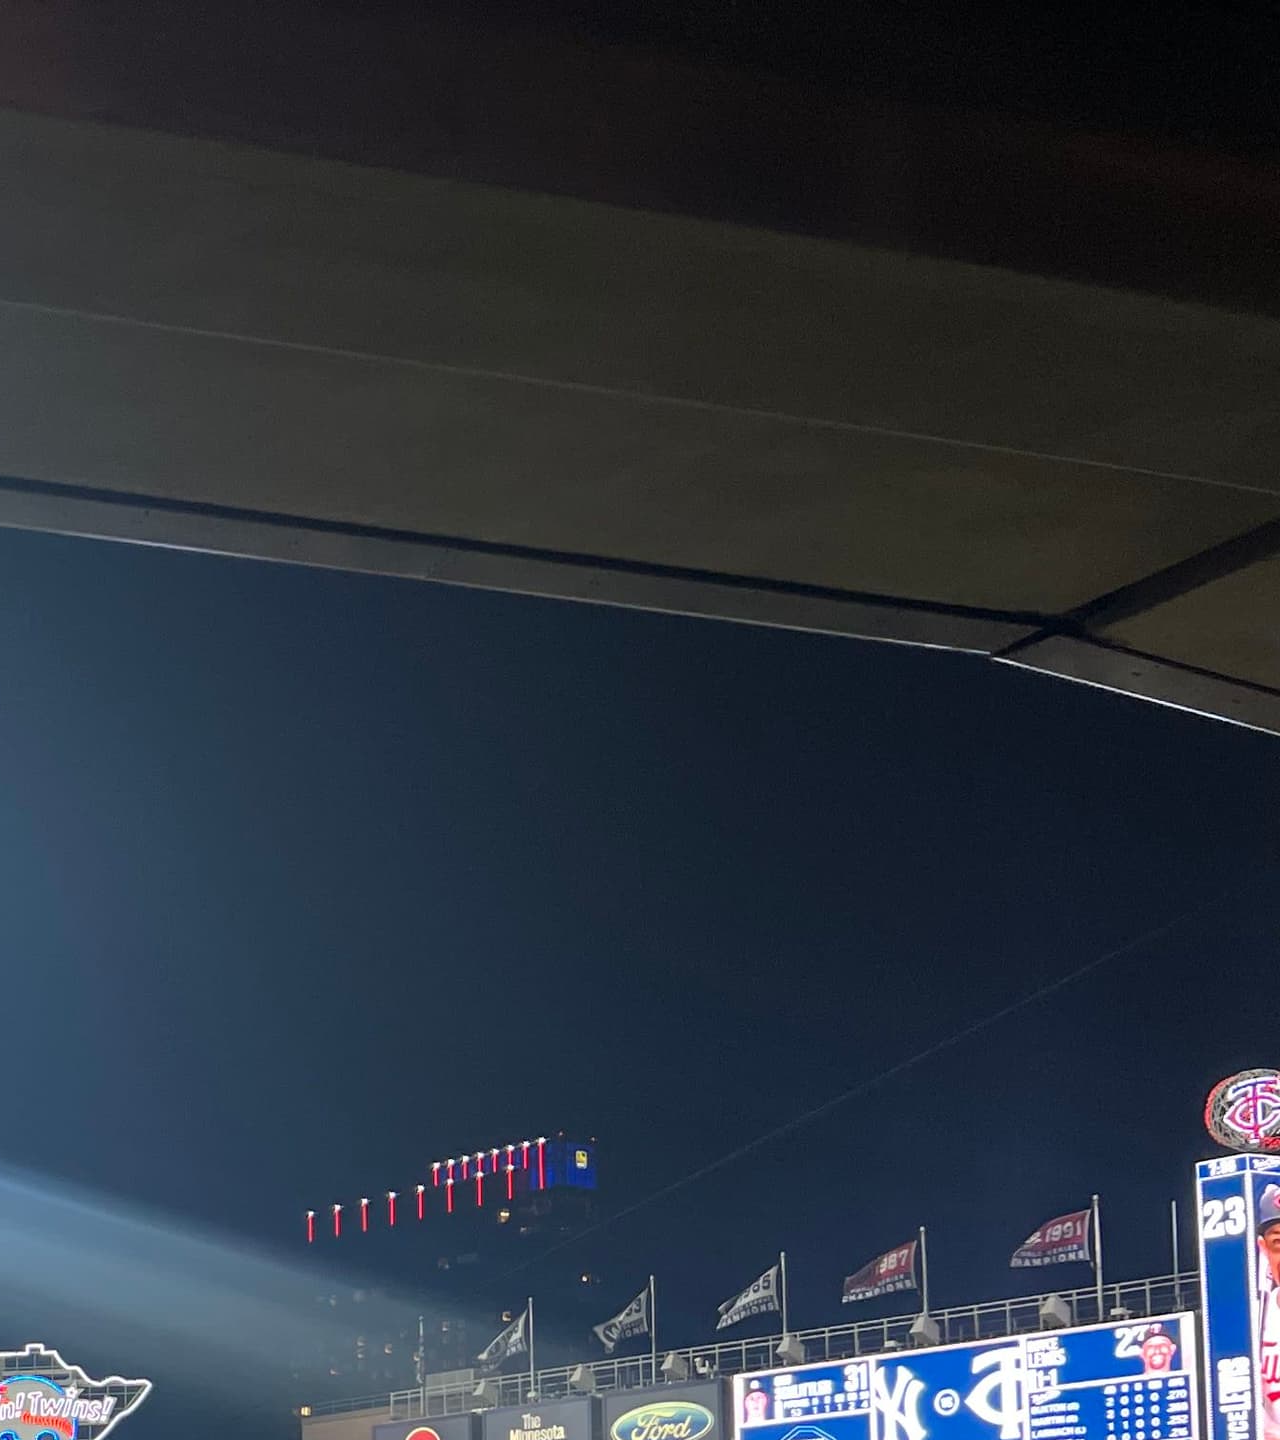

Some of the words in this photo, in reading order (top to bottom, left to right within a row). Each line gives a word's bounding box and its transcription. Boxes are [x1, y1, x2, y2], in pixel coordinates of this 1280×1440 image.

[1044, 1220, 1083, 1244] 1991
[1203, 1195, 1246, 1239] 23
[1219, 1355, 1251, 1413] LEWIS
[27, 1390, 117, 1424] Twins!
[521, 1413, 540, 1429] The
